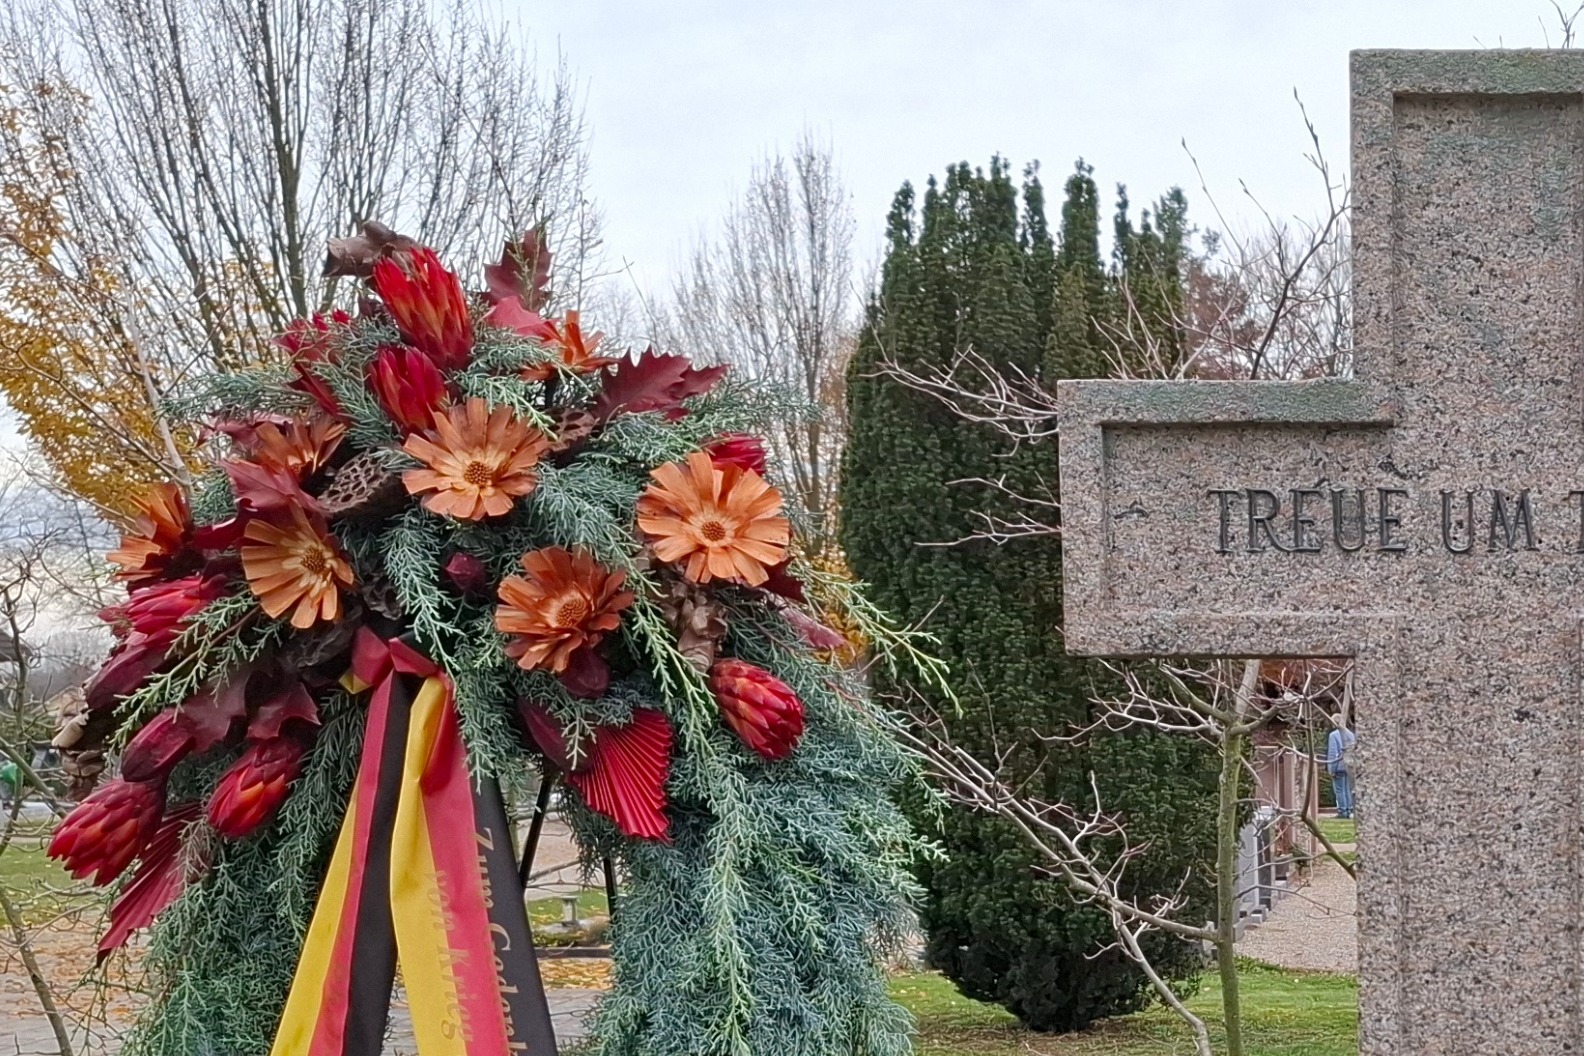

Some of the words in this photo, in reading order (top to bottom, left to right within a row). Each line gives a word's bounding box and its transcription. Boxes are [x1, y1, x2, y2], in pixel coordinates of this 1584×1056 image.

[1206, 485, 1409, 555] TREUE
[1439, 486, 1540, 555] UM
[426, 869, 456, 933] von
[470, 826, 495, 909] Zum
[436, 944, 478, 1043] Krieg
